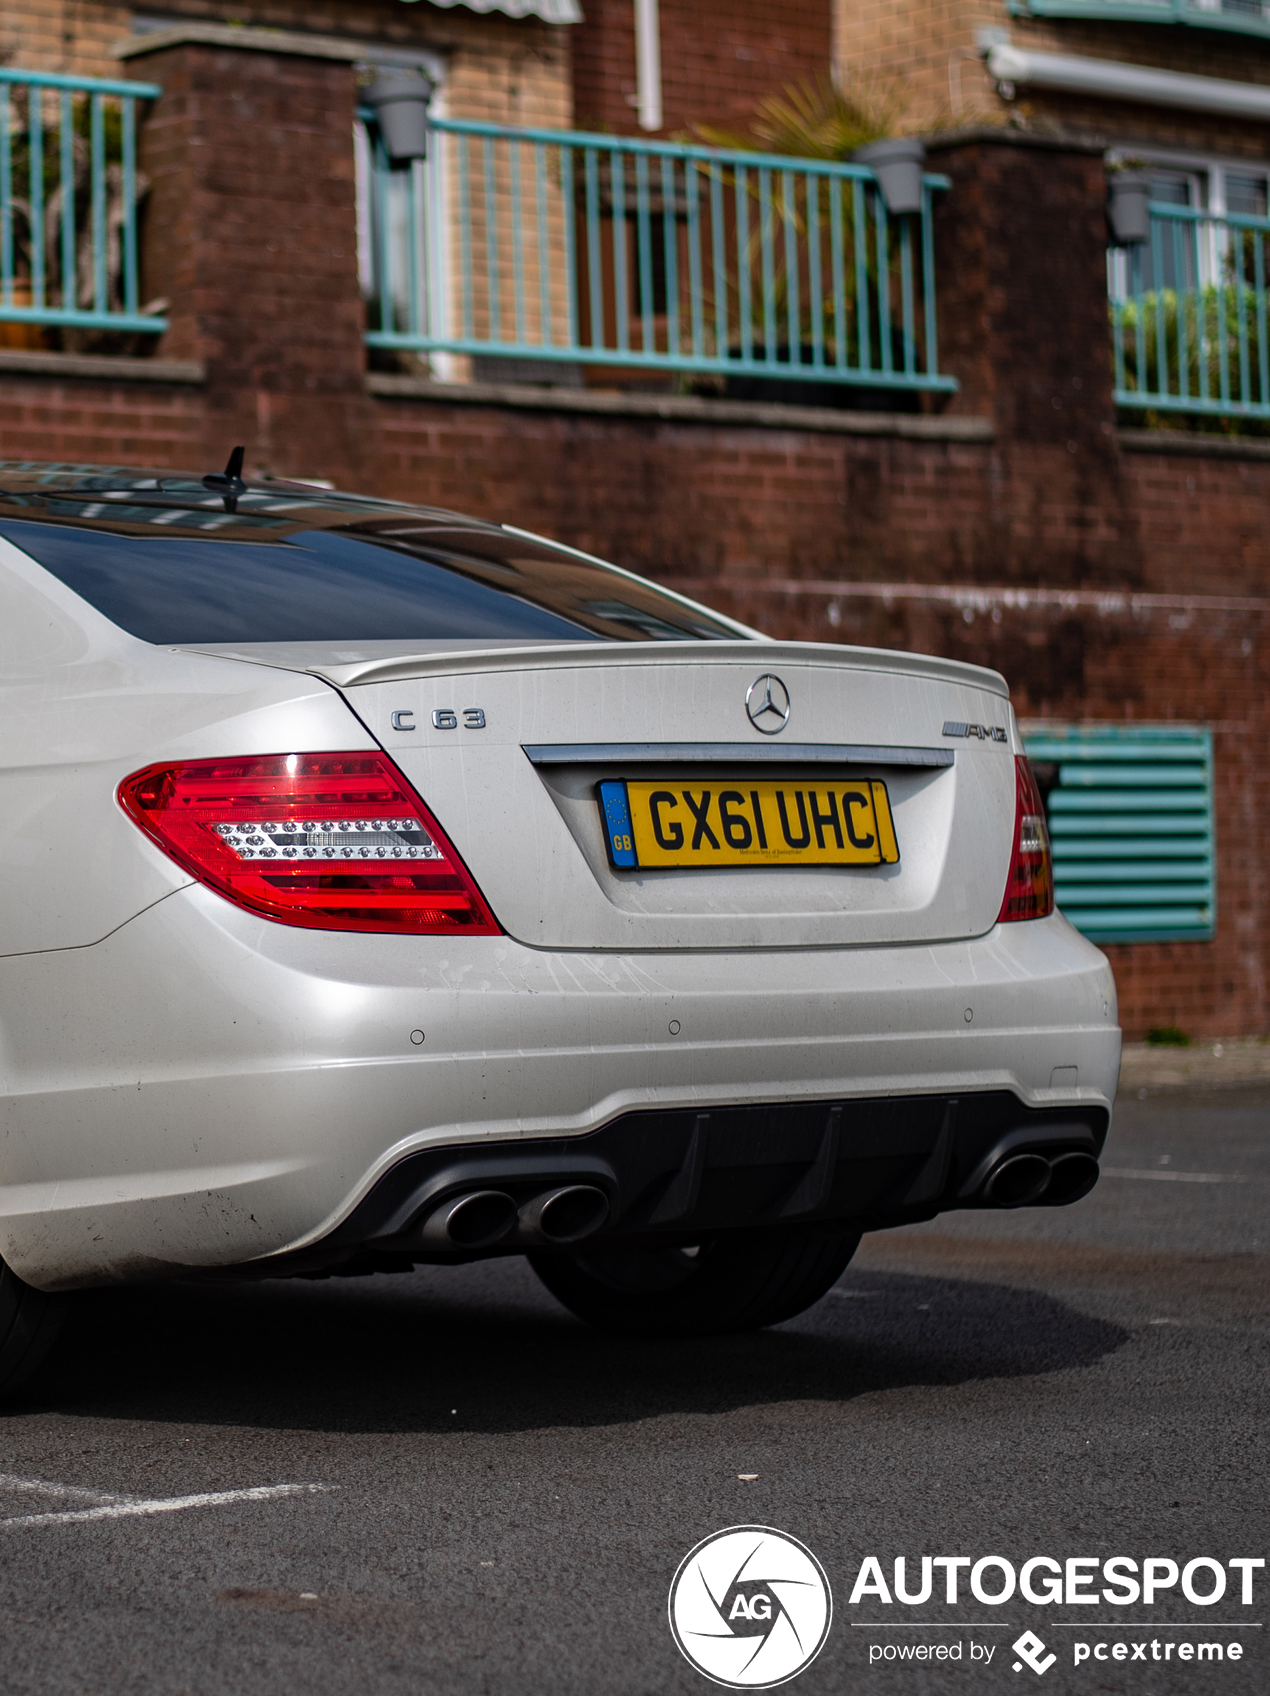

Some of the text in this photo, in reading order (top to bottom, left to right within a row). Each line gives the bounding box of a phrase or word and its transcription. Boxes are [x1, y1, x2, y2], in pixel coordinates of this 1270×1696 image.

[391, 708, 486, 731] C 63
[965, 724, 1008, 743] AMG
[648, 791, 875, 850] GX61 UHC
[613, 835, 632, 851] GB
